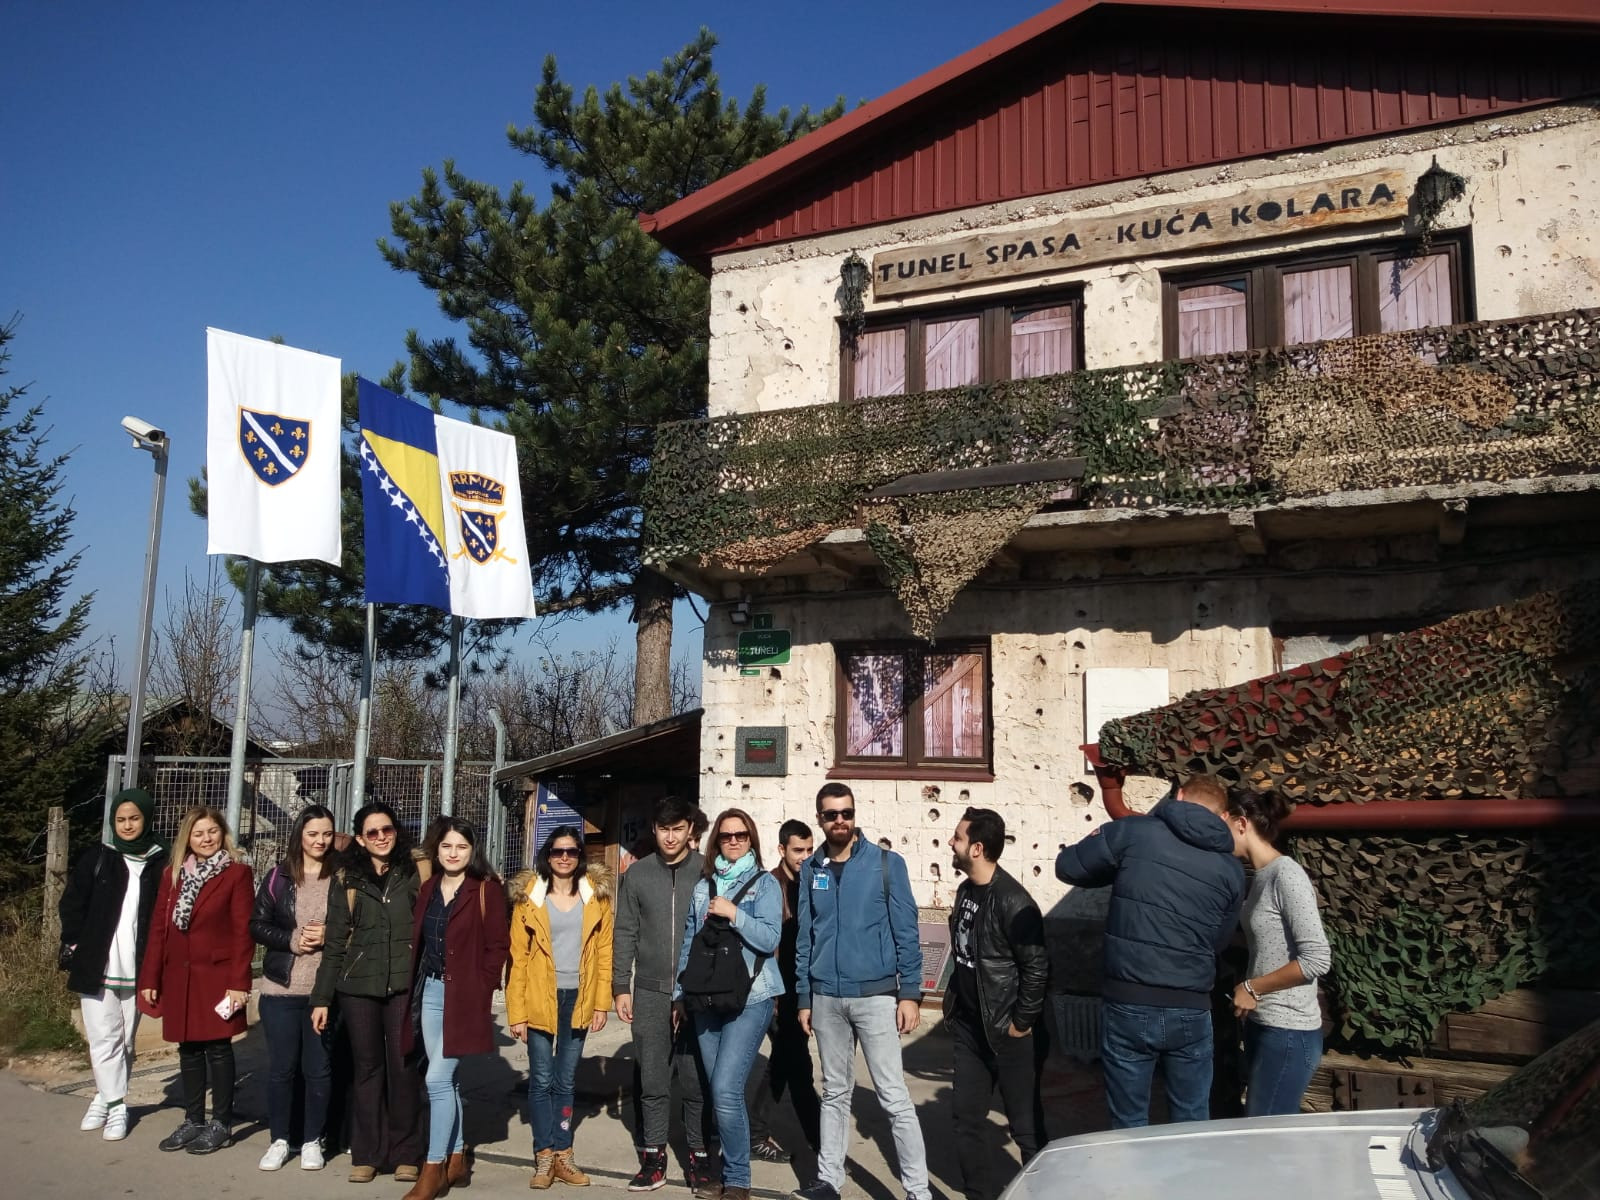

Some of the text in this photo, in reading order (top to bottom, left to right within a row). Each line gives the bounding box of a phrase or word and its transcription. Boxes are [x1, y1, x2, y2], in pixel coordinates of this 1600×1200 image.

[878, 251, 973, 282] TUNEL
[985, 233, 1081, 265] SPASA
[1116, 208, 1213, 244] KUĆA
[1230, 183, 1394, 227] KOLARA
[452, 474, 504, 495] ARMIJA
